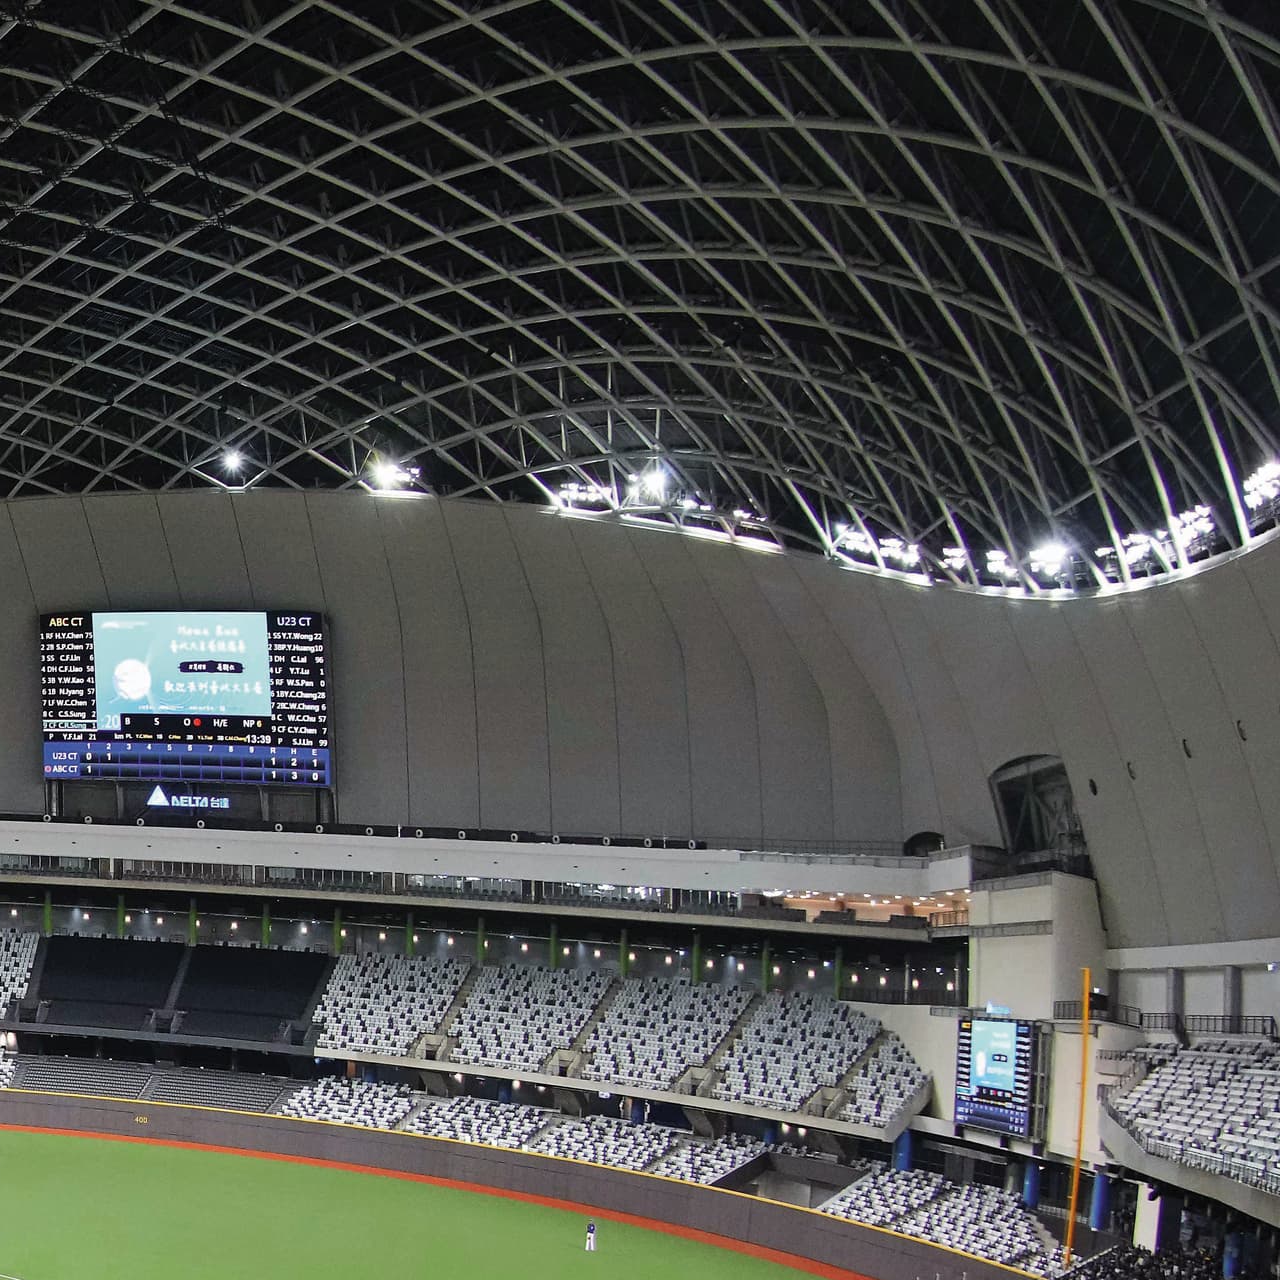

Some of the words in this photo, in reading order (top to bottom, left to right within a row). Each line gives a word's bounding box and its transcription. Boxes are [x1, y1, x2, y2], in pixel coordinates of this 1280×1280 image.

[50, 618, 69, 626] ABC
[71, 618, 83, 626] CT
[277, 617, 296, 626] U23
[299, 618, 311, 626] CT
[154, 718, 159, 726] S
[184, 718, 190, 726] O
[214, 719, 228, 727] H/E
[243, 720, 255, 728] NP
[246, 735, 271, 743] 13:39
[172, 796, 208, 807] DELTA
